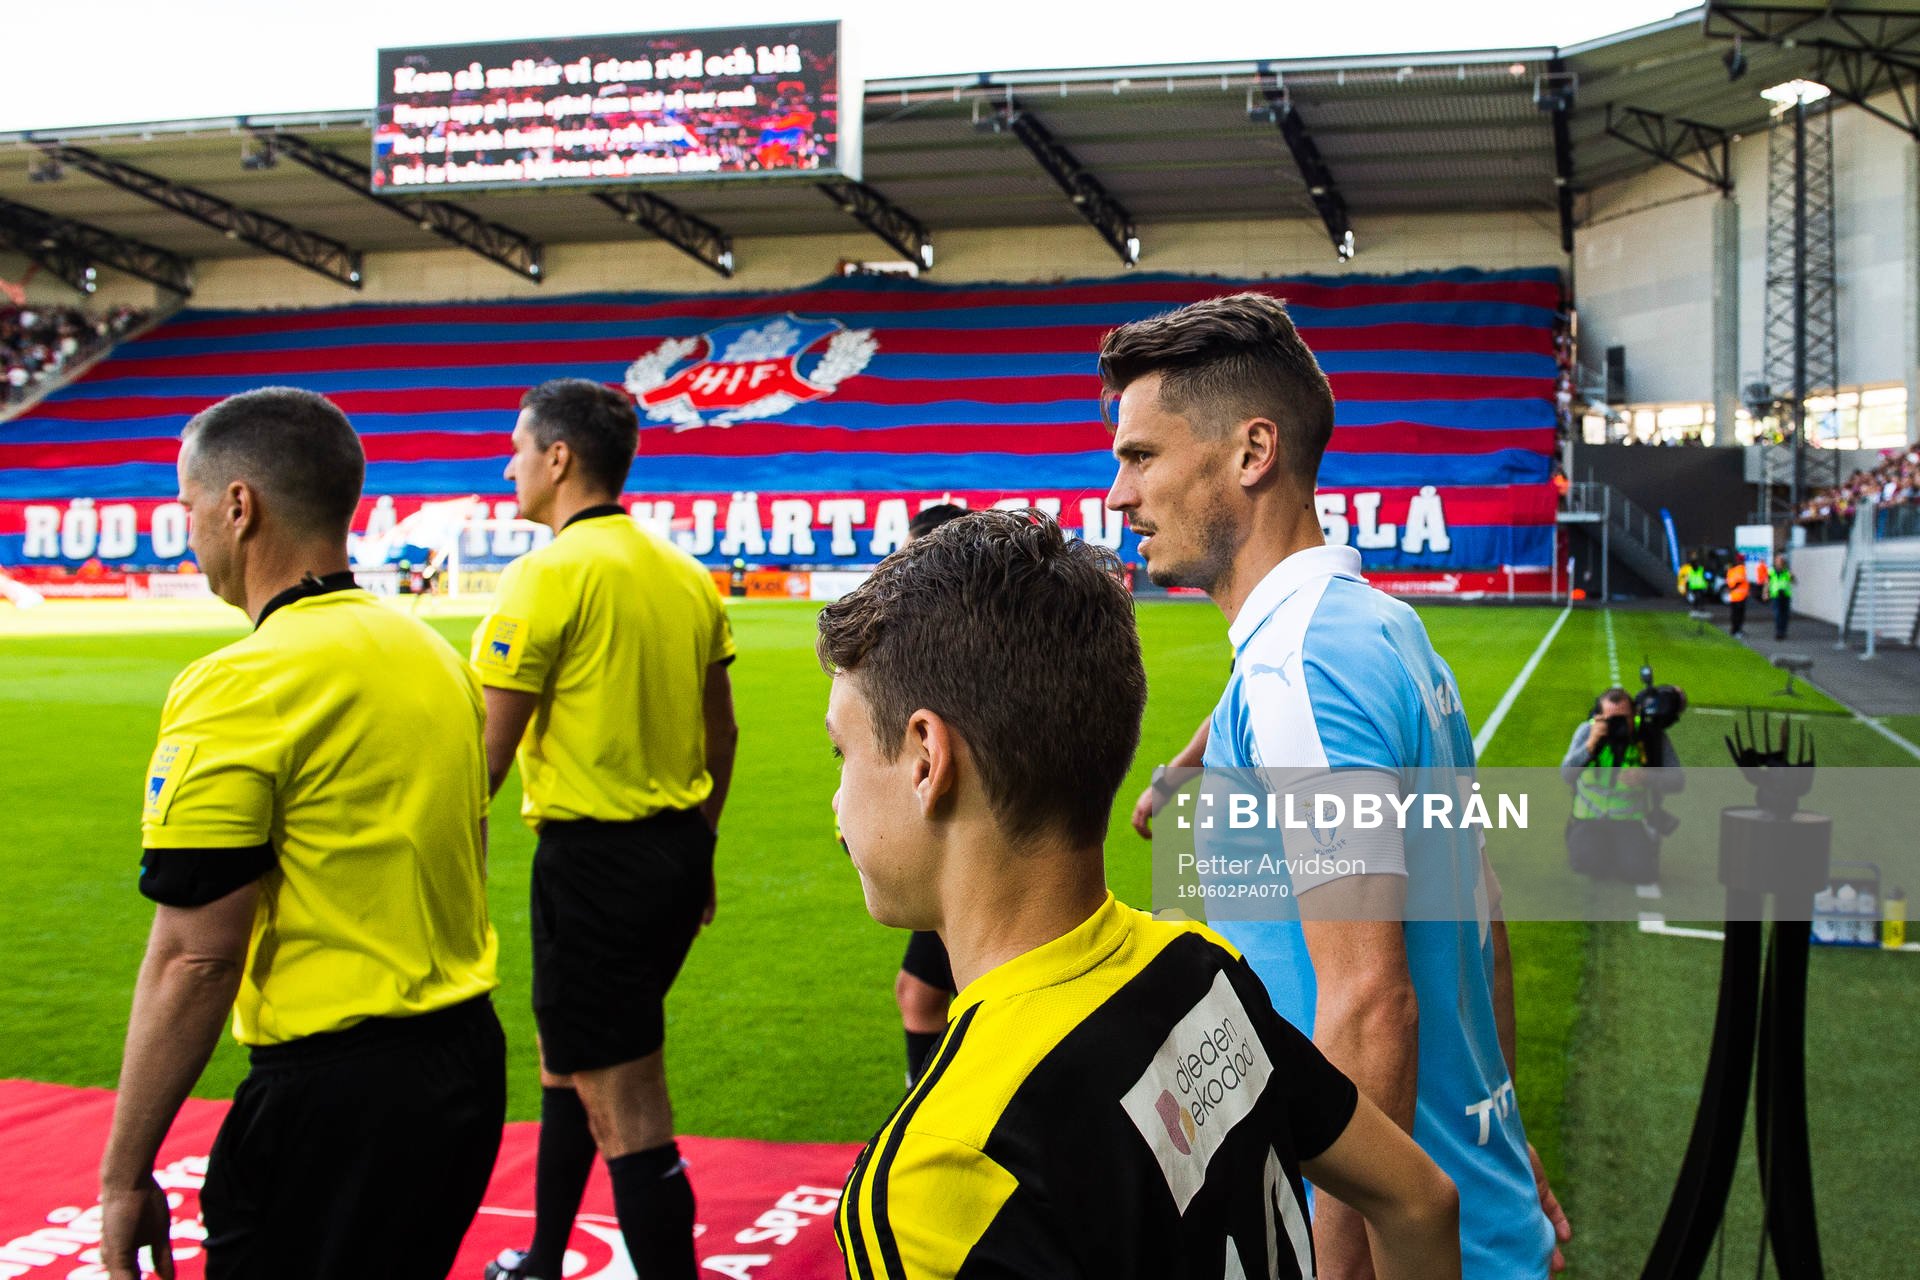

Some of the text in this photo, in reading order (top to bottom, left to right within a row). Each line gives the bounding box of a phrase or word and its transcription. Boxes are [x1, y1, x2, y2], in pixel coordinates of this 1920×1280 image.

[394, 44, 802, 94] Kom så målar vi stan röd och blå
[23, 498, 137, 560] RÖD
[630, 491, 967, 556] HJÄRTA
[1314, 485, 1450, 554] SLÅ
[1176, 1017, 1238, 1094] dieden
